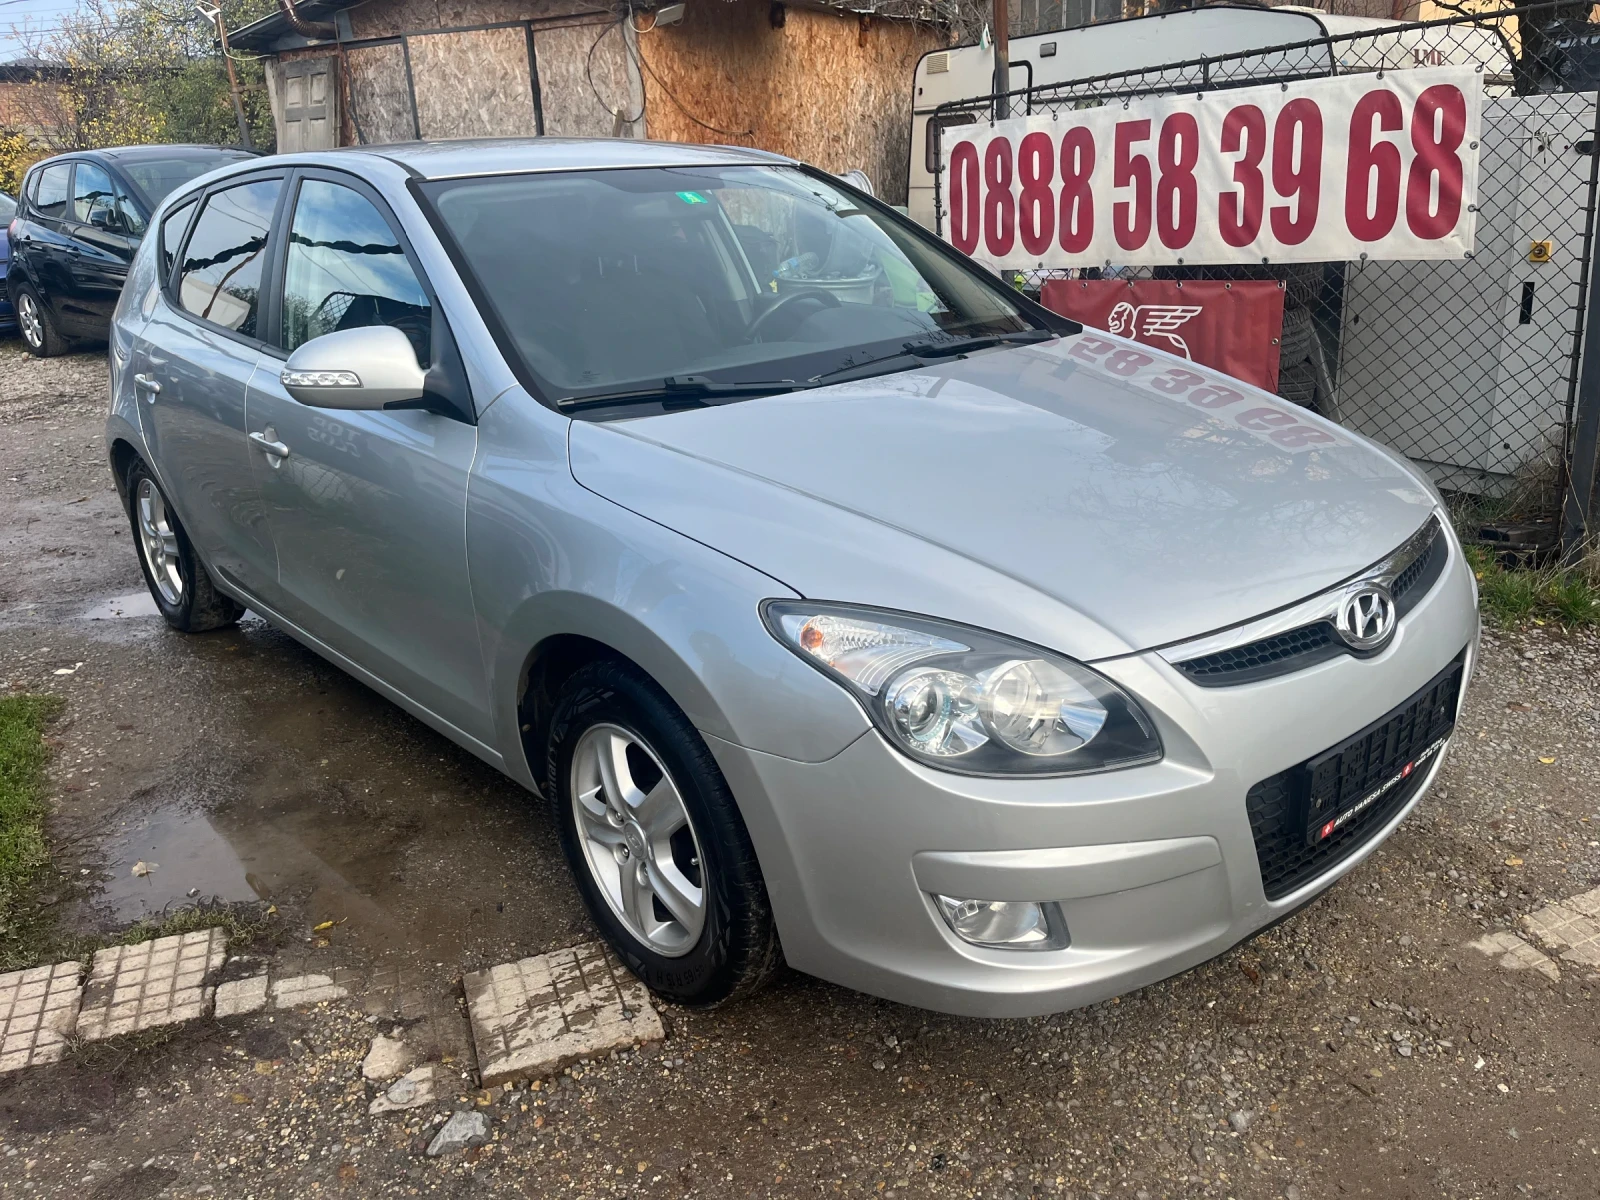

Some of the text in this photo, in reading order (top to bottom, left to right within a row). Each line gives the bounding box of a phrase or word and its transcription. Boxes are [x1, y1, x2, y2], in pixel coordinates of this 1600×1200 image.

[950, 84, 1466, 256] 0888 58 39 68
